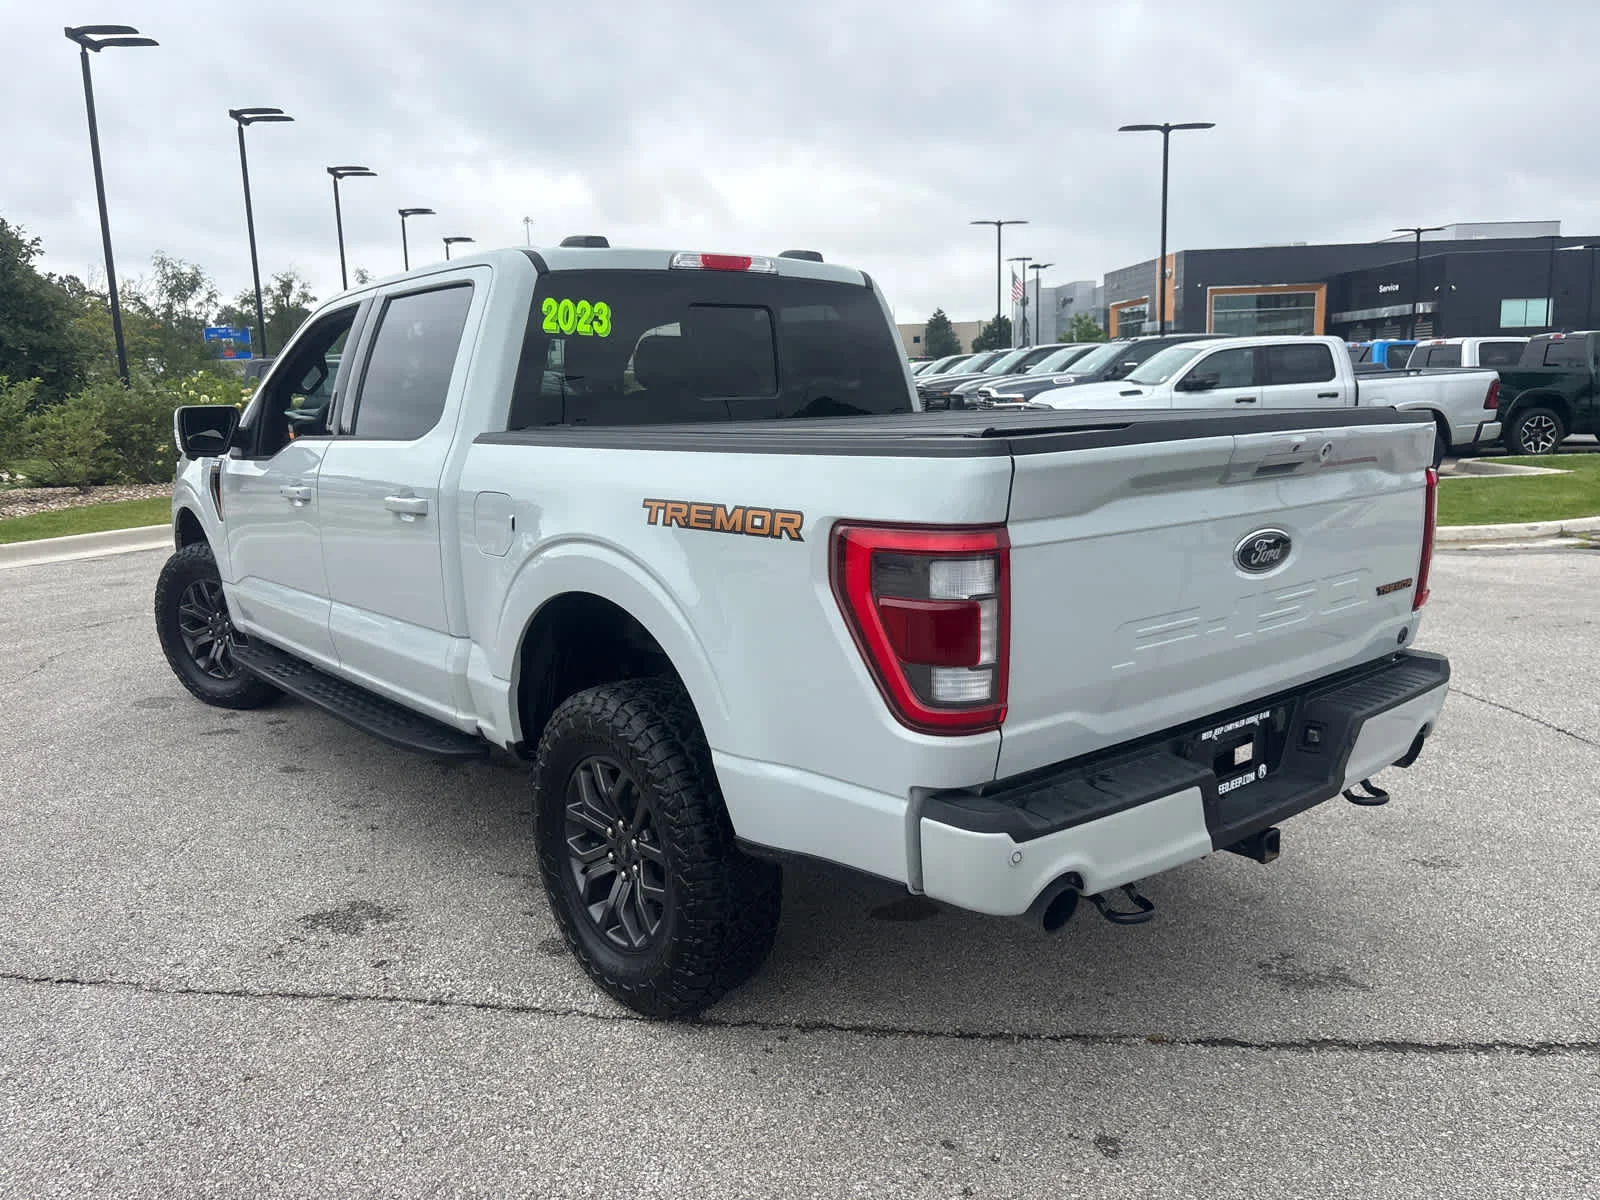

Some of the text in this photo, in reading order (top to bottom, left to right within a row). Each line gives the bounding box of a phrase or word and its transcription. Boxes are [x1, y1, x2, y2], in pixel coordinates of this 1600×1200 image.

[1379, 283, 1400, 293] Service
[542, 297, 611, 338] 2023
[642, 498, 805, 543] TREMOR
[1250, 539, 1283, 565] Ford
